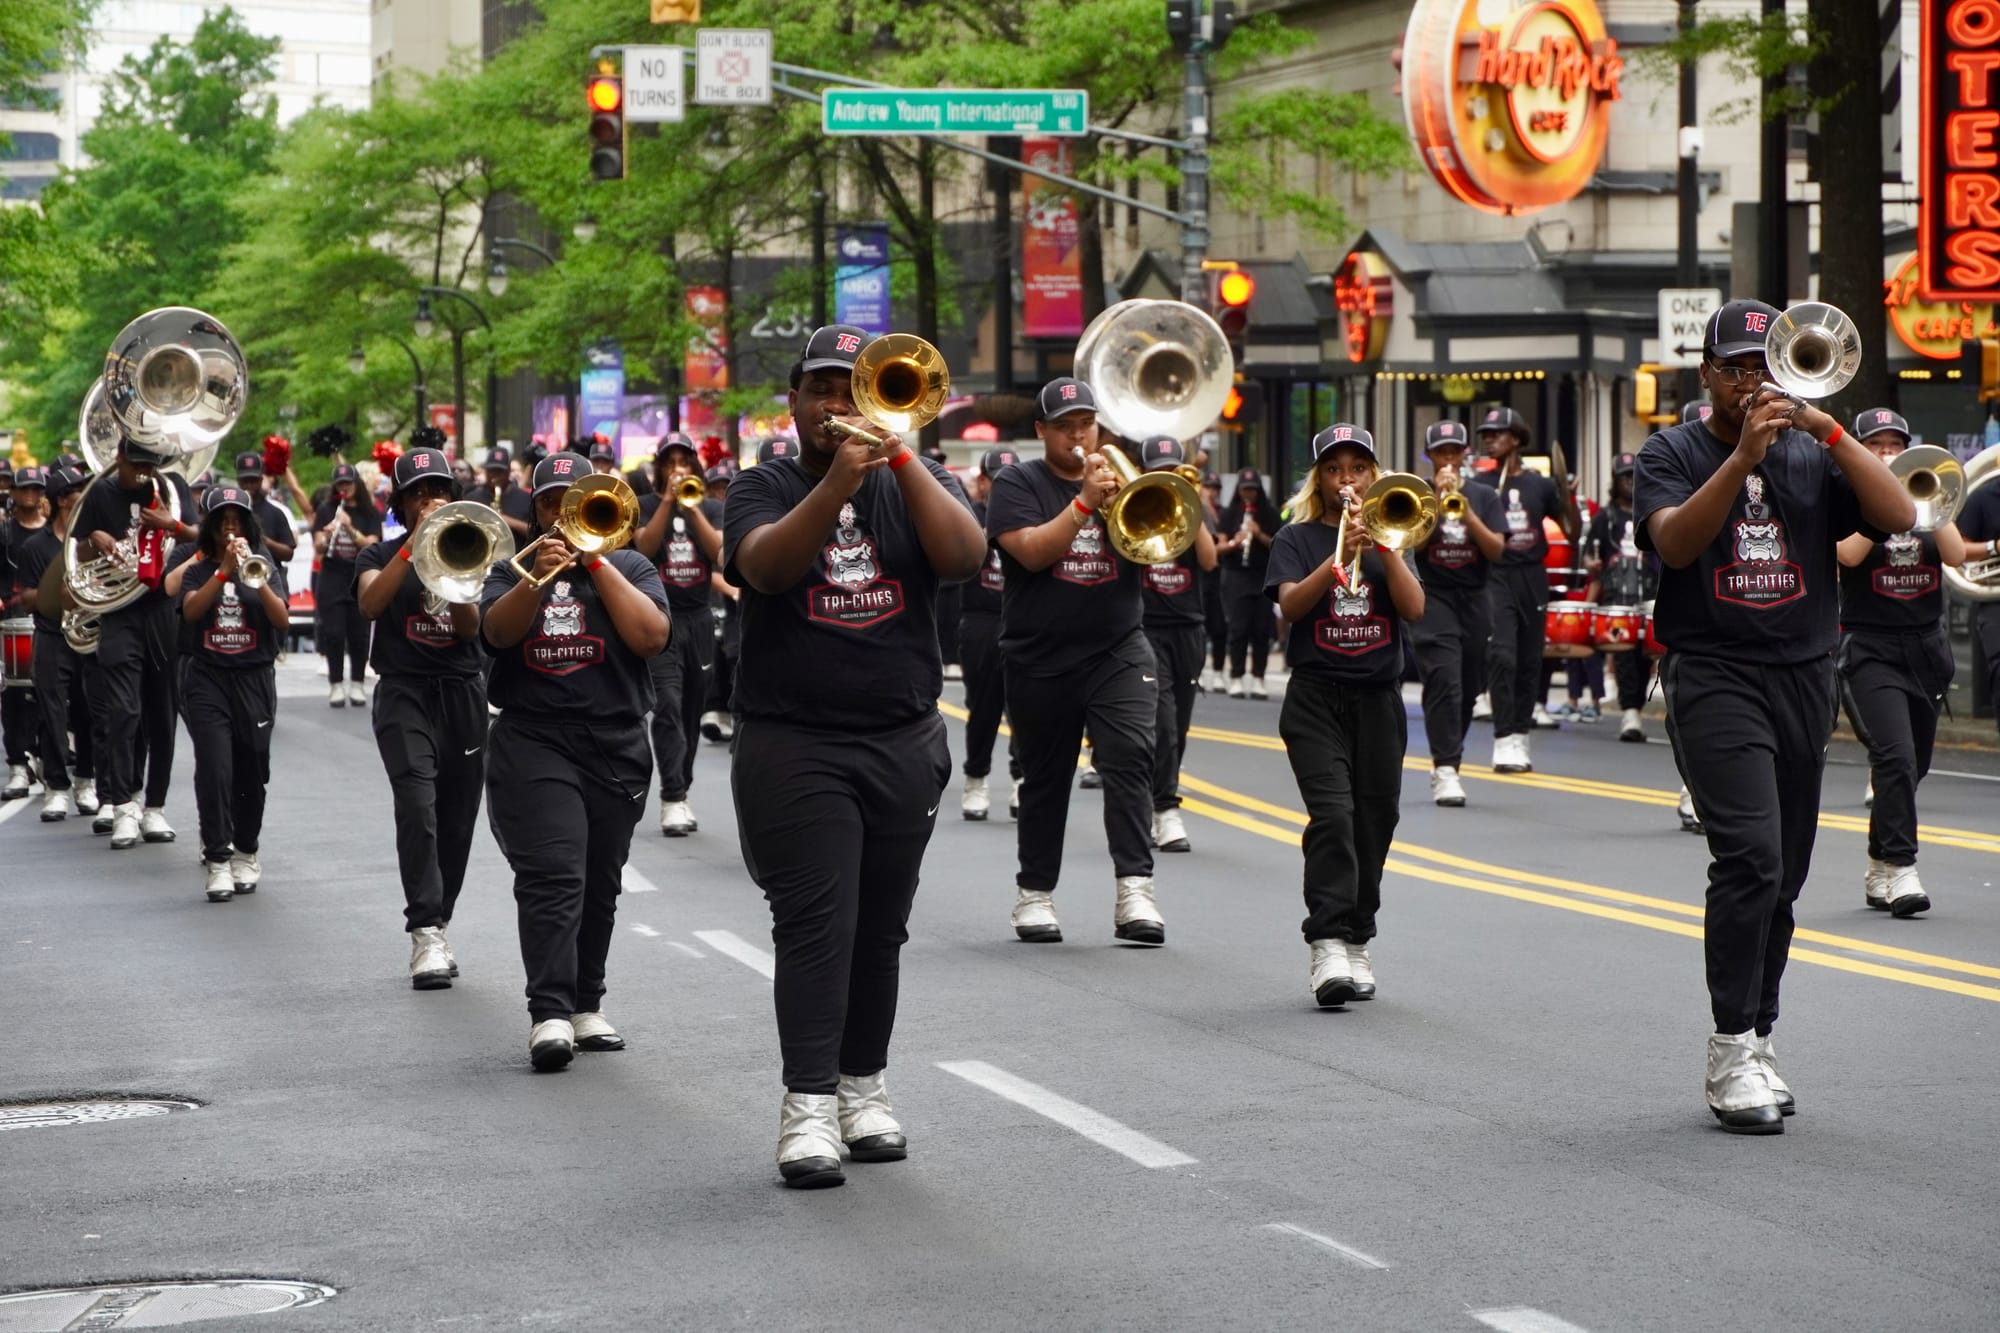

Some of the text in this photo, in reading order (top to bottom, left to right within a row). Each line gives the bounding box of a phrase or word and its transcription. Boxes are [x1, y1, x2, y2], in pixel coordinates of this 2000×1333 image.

[700, 35, 765, 47] DON'T BLOCK
[640, 58, 665, 79] NO
[1476, 29, 1623, 101] Hard Rock
[629, 89, 676, 106] TURNS
[704, 86, 762, 98] THE BOX
[833, 95, 1079, 129] Andrew Young International BLVD
[1058, 116, 1072, 130] NE
[1671, 298, 1708, 314] ONE
[1745, 311, 1768, 333] TC
[836, 332, 862, 353] TC
[1060, 384, 1077, 400] TC
[1333, 427, 1353, 442] TC
[412, 453, 430, 470] TC
[553, 459, 573, 475] TC
[1062, 561, 1110, 573] TRI-CITIES
[1728, 574, 1795, 590] TRI-CITIES
[1882, 574, 1930, 586] TRI-CITIES
[822, 590, 893, 610] TRI-CITIES
[1325, 625, 1381, 639] TRI-CITIES
[534, 645, 594, 660] TRI-CITIES
